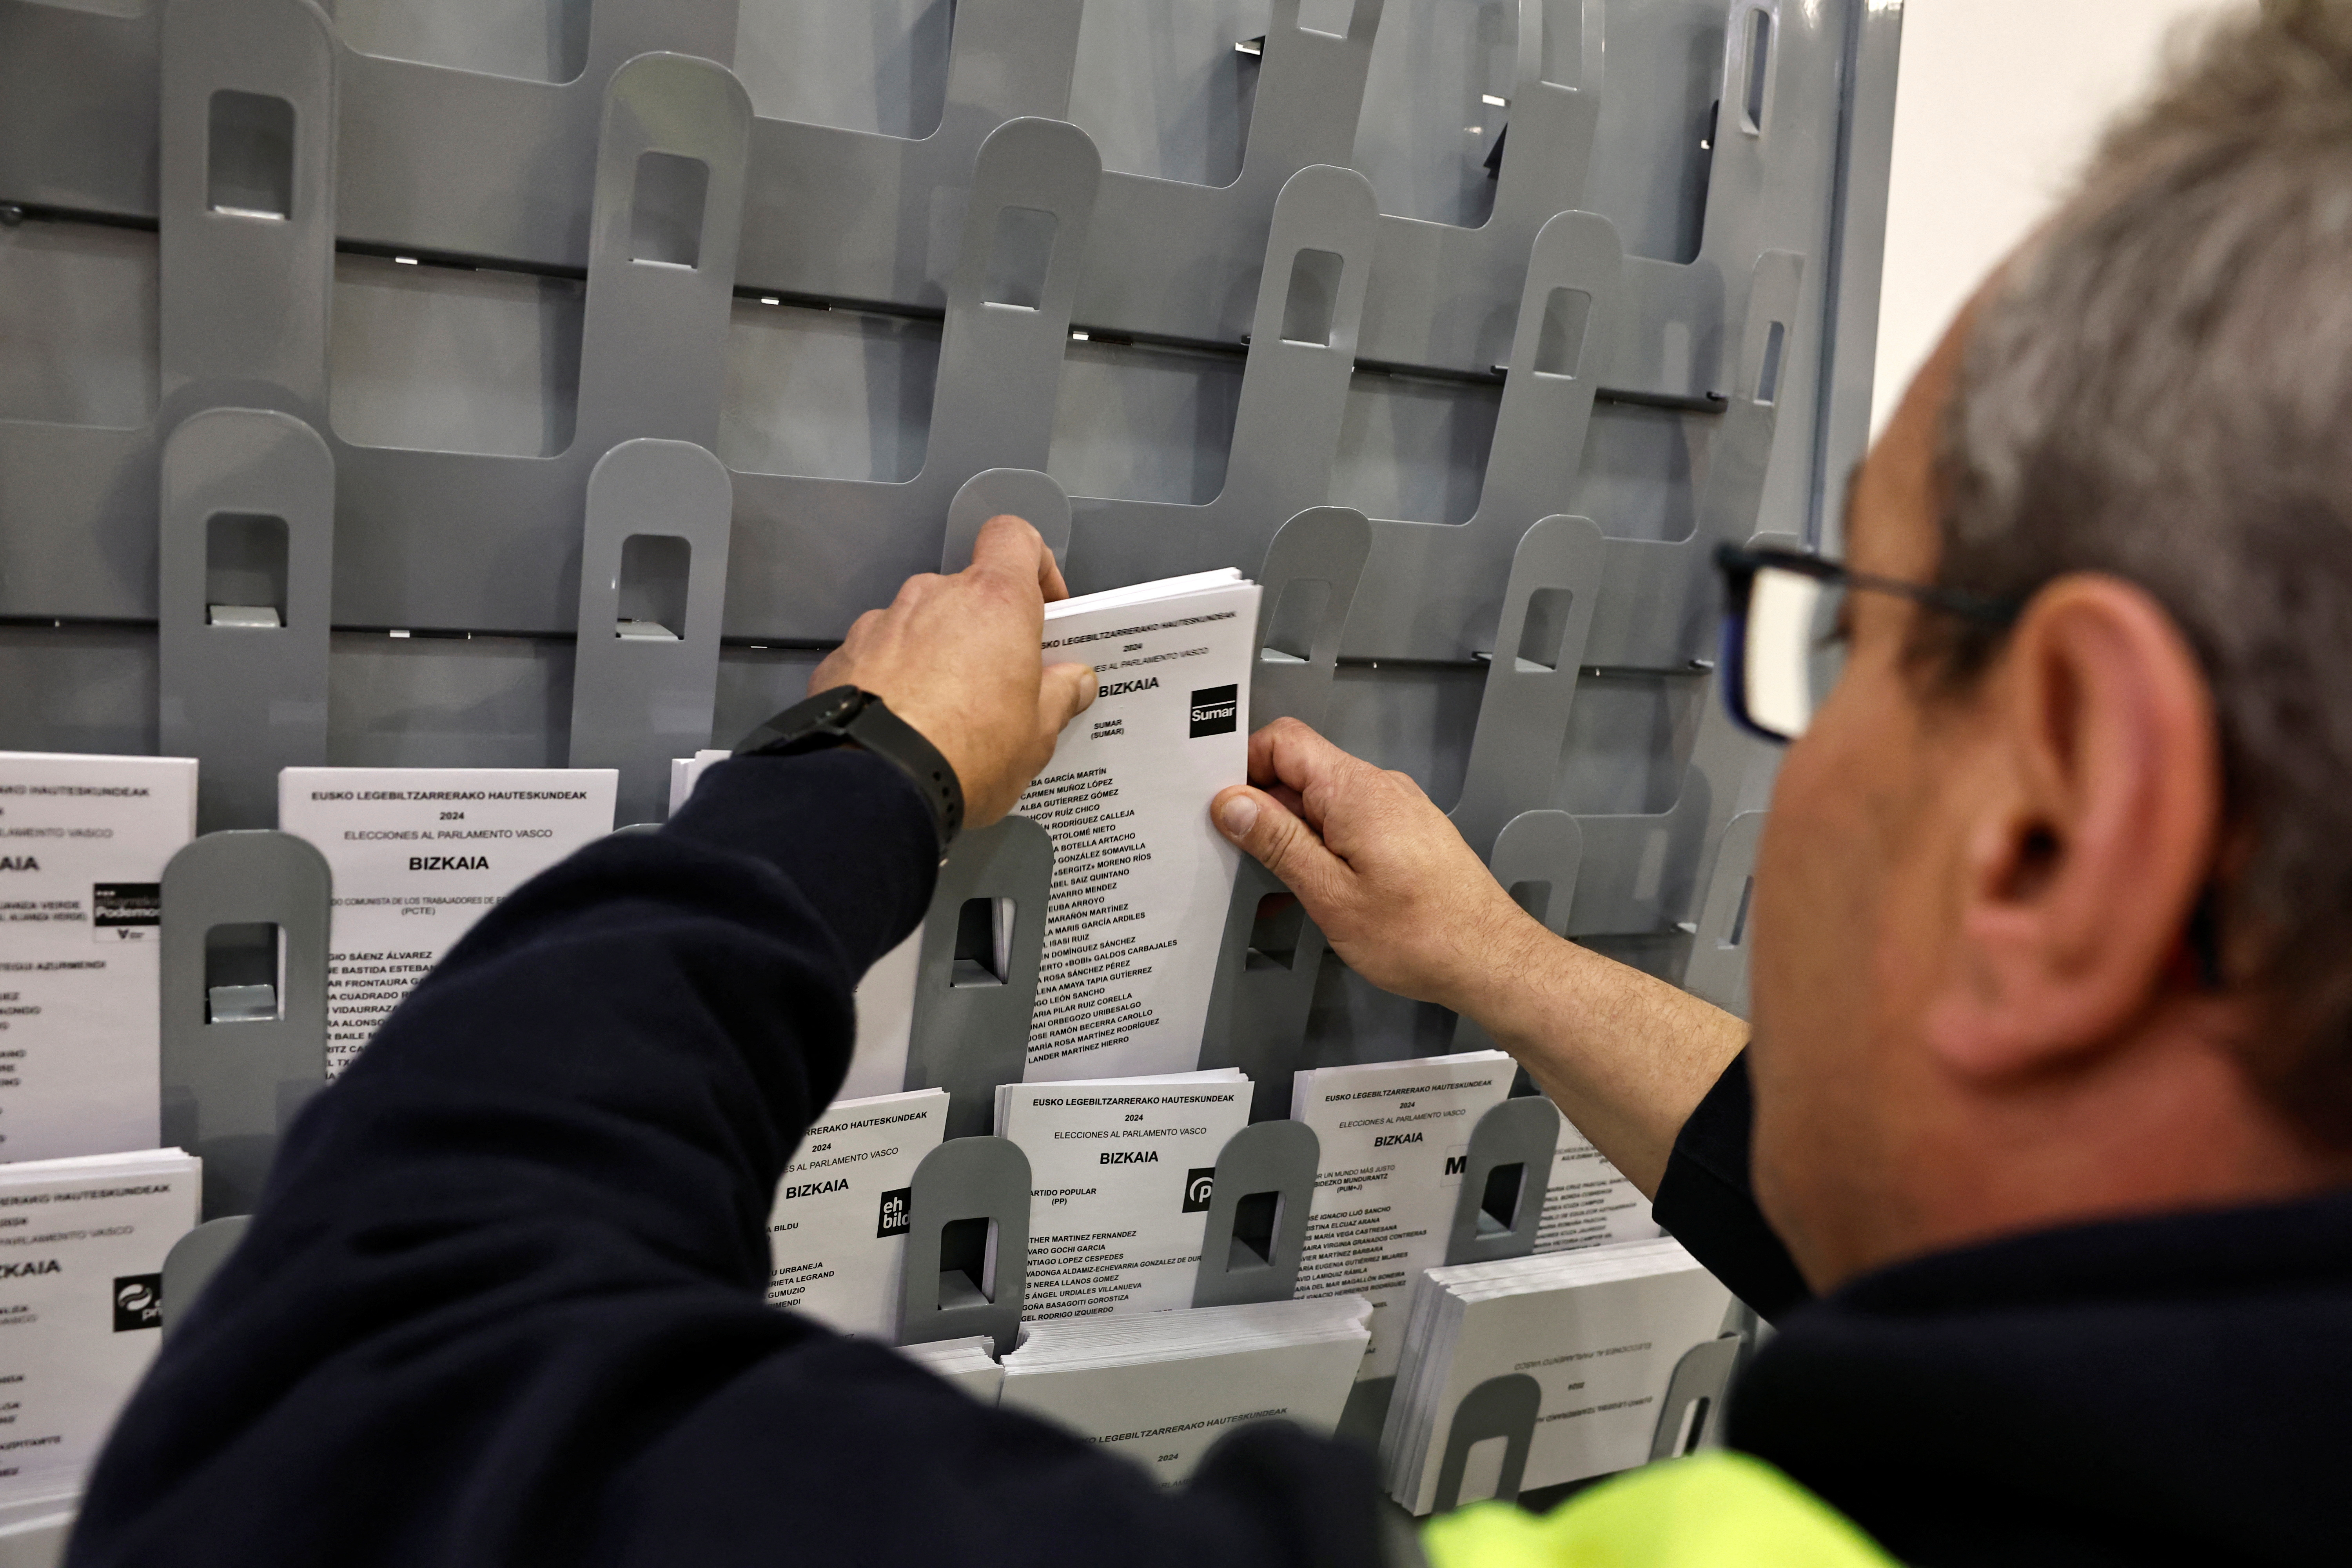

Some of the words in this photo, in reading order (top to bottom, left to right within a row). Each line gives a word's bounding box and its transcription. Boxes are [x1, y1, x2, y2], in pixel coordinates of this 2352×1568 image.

[1062, 624, 1158, 646] LEGEBILTZARRERAKO
[1123, 643, 1142, 652] 2024
[1108, 662, 1118, 671] AL
[1121, 652, 1178, 669] PARLAMENTO
[1180, 647, 1209, 657] VASCO
[1099, 677, 1160, 697] BIZKAIA
[1192, 707, 1235, 721] Sumar
[1094, 719, 1122, 729] SUMAR
[1091, 728, 1124, 740] (SUMAR)
[1044, 773, 1074, 784] GARCÍA
[1077, 768, 1107, 779] MARTÍN
[312, 791, 354, 800] EUSKO
[357, 791, 485, 800] LEGEBILTZARRERAKO
[488, 791, 586, 800] HAUTESKUNDEAK
[1021, 789, 1054, 800] CARMEN
[1057, 783, 1085, 793] MUÑOZ
[1087, 779, 1112, 788] LÓPEZ
[1020, 802, 1042, 811] ALBA
[1044, 795, 1088, 808] GUTÍERREZ
[1091, 789, 1118, 799] GÓMEZ
[1055, 808, 1073, 816] RUÍZ
[1075, 804, 1100, 813] CHICO
[1052, 815, 1098, 829] RODRÍGUEZ
[1100, 809, 1135, 821] CALLEJA
[345, 831, 418, 840] ELECCIONES
[421, 831, 434, 839] AL
[437, 830, 512, 838] PARLAMENTO
[1093, 824, 1116, 833] NIETO
[1061, 839, 1096, 851] BOTELLA
[1098, 833, 1135, 845] ARTACHO
[1058, 850, 1100, 863] GONZÁLEZ
[1102, 843, 1145, 856] SOMAVILLA
[409, 857, 489, 871] BIZKAIA
[1097, 858, 1131, 868] MORENO
[1133, 853, 1151, 861] RÍOS
[1090, 869, 1129, 881] QUINTANO
[1085, 883, 1117, 893] MENDEZ
[1072, 897, 1104, 908] ARROYO
[402, 907, 435, 916] (PCTE)
[1048, 911, 1087, 924] MARAÑÓN
[1090, 904, 1128, 916] MARTÍNEZ
[1055, 924, 1079, 934] MARIS
[1082, 919, 1111, 929] GARCÍA
[1112, 912, 1145, 924] ARDILES
[1072, 934, 1089, 942] RUIZ
[1052, 944, 1098, 958] DOMÍNGUEZ
[1100, 937, 1136, 949] SÁNCHEZ
[1094, 950, 1125, 961] GALDOS
[1128, 940, 1177, 955] CARBAJALES
[350, 952, 383, 960] SÁENZ
[387, 951, 432, 960] ÁLVAREZ
[1044, 973, 1065, 982] ROSA
[1068, 966, 1103, 978] SÁNCHEZ
[1106, 960, 1130, 970] PÉREZ
[345, 978, 408, 987] FRONTAURA
[1059, 980, 1084, 991] AMAYA
[1086, 976, 1108, 985] TAPIA
[1110, 967, 1152, 980] GUTÍERREZ
[340, 992, 398, 1000] CUADRADO
[1050, 994, 1070, 1004] LEÓN
[1073, 987, 1105, 999] SANCHO
[1053, 1005, 1076, 1014] PILAR
[1078, 1000, 1095, 1009] RUIZ
[1097, 993, 1132, 1005] CORELLA
[1048, 1013, 1091, 1026] ORBEGOZO
[1093, 1002, 1141, 1017] URIBESALGO
[1029, 1032, 1047, 1042] JOSE
[1050, 1025, 1077, 1036] RAMÓN
[1080, 1019, 1116, 1031] BECERRA
[1118, 1009, 1152, 1022] CAROLLO
[1028, 1041, 1053, 1053] MARÍA
[1054, 1037, 1076, 1046] ROSA
[1078, 1028, 1115, 1042] MARTÍNEZ
[1117, 1018, 1159, 1033] RODRÍGUEZ
[1028, 1052, 1059, 1063] LANDER
[1062, 1043, 1099, 1056] MARTÍNEZ
[1101, 1036, 1129, 1048] HIERRO
[1353, 1086, 1430, 1099] LEGEBILTZARRERAKO
[1432, 1080, 1492, 1091] HAUTESKUNDEAK
[1066, 1097, 1160, 1105] LEGEBILTZARRERAKO
[1161, 1095, 1234, 1103] HAUTESKUNDEAK
[850, 1112, 927, 1129] HAUTESKUNDEAK
[1339, 1119, 1384, 1128] ELECCIONES
[1396, 1112, 1441, 1123] PARLAMENTO
[1123, 1129, 1177, 1137] PARLAMENTO
[1375, 1132, 1423, 1147] BIZKAIA
[812, 1143, 831, 1152] 2024
[797, 1163, 808, 1171] AL
[810, 1152, 867, 1169] PARLAMENTO
[870, 1147, 898, 1159] VASCO
[1100, 1151, 1158, 1164] BIZKAIA
[1335, 1169, 1358, 1177] MUNDO
[1344, 1174, 1388, 1184] MUNDURANTZ
[786, 1178, 849, 1199] BIZKAIA
[884, 1197, 902, 1213] eh
[774, 1223, 799, 1232] BILDU
[1092, 1231, 1136, 1240] FERNANDEZ
[1085, 1254, 1123, 1262] CESPEDES
[780, 1262, 822, 1274] URBANEJA
[1062, 1262, 1138, 1275] ALDAMIZ-ECHEVARRIA
[1140, 1258, 1175, 1267] GONZALEZ
[796, 1271, 834, 1283] LEGRAND
[768, 1287, 805, 1298] GUMUZIO
[1032, 1291, 1057, 1299] ÁNGEL
[1060, 1288, 1096, 1296] URDIALES
[1098, 1283, 1142, 1293] VILLANUEVA
[1046, 1299, 1086, 1309] BASAGOITI
[1088, 1295, 1129, 1304] GOROSTIZA
[1038, 1311, 1073, 1320] RODRIGO
[1074, 1307, 1113, 1316] IZQUIERDO
[1098, 1422, 1205, 1443] LEGEBILTZARRERAKO
[1207, 1408, 1287, 1426] HAUTESKUNDEAK
[1158, 1454, 1178, 1462] 2024
